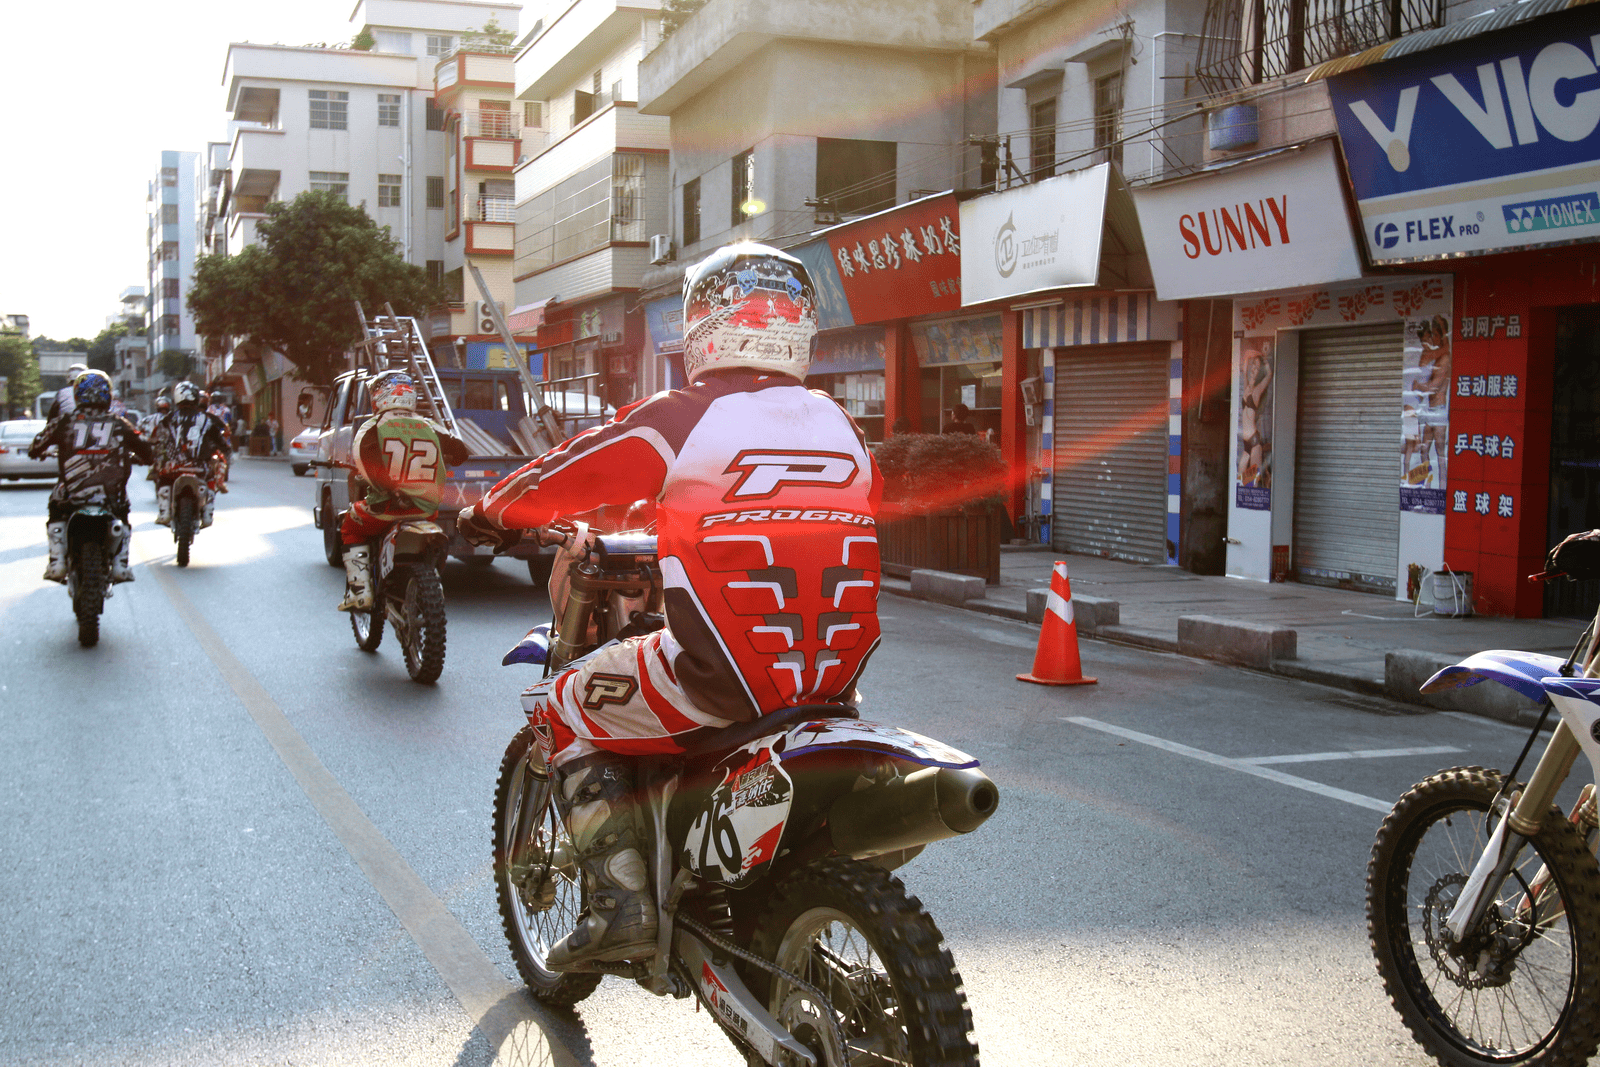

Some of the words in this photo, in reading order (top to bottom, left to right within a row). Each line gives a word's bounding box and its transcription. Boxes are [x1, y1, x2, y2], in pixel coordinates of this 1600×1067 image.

[1429, 34, 1600, 149] VIC
[1179, 194, 1290, 259] SUNNY
[1539, 199, 1596, 228] YONEX
[1405, 215, 1456, 243] FLEX
[1459, 224, 1480, 236] PRO
[1460, 315, 1521, 338] 羽网产品
[1456, 375, 1518, 398] 运动服装
[73, 422, 113, 448] 14
[1454, 433, 1515, 459] 乒乓球台
[382, 437, 439, 483] 12
[1453, 490, 1514, 518] 篮球架
[702, 509, 876, 528] PROGRIP
[694, 785, 743, 882] 26
